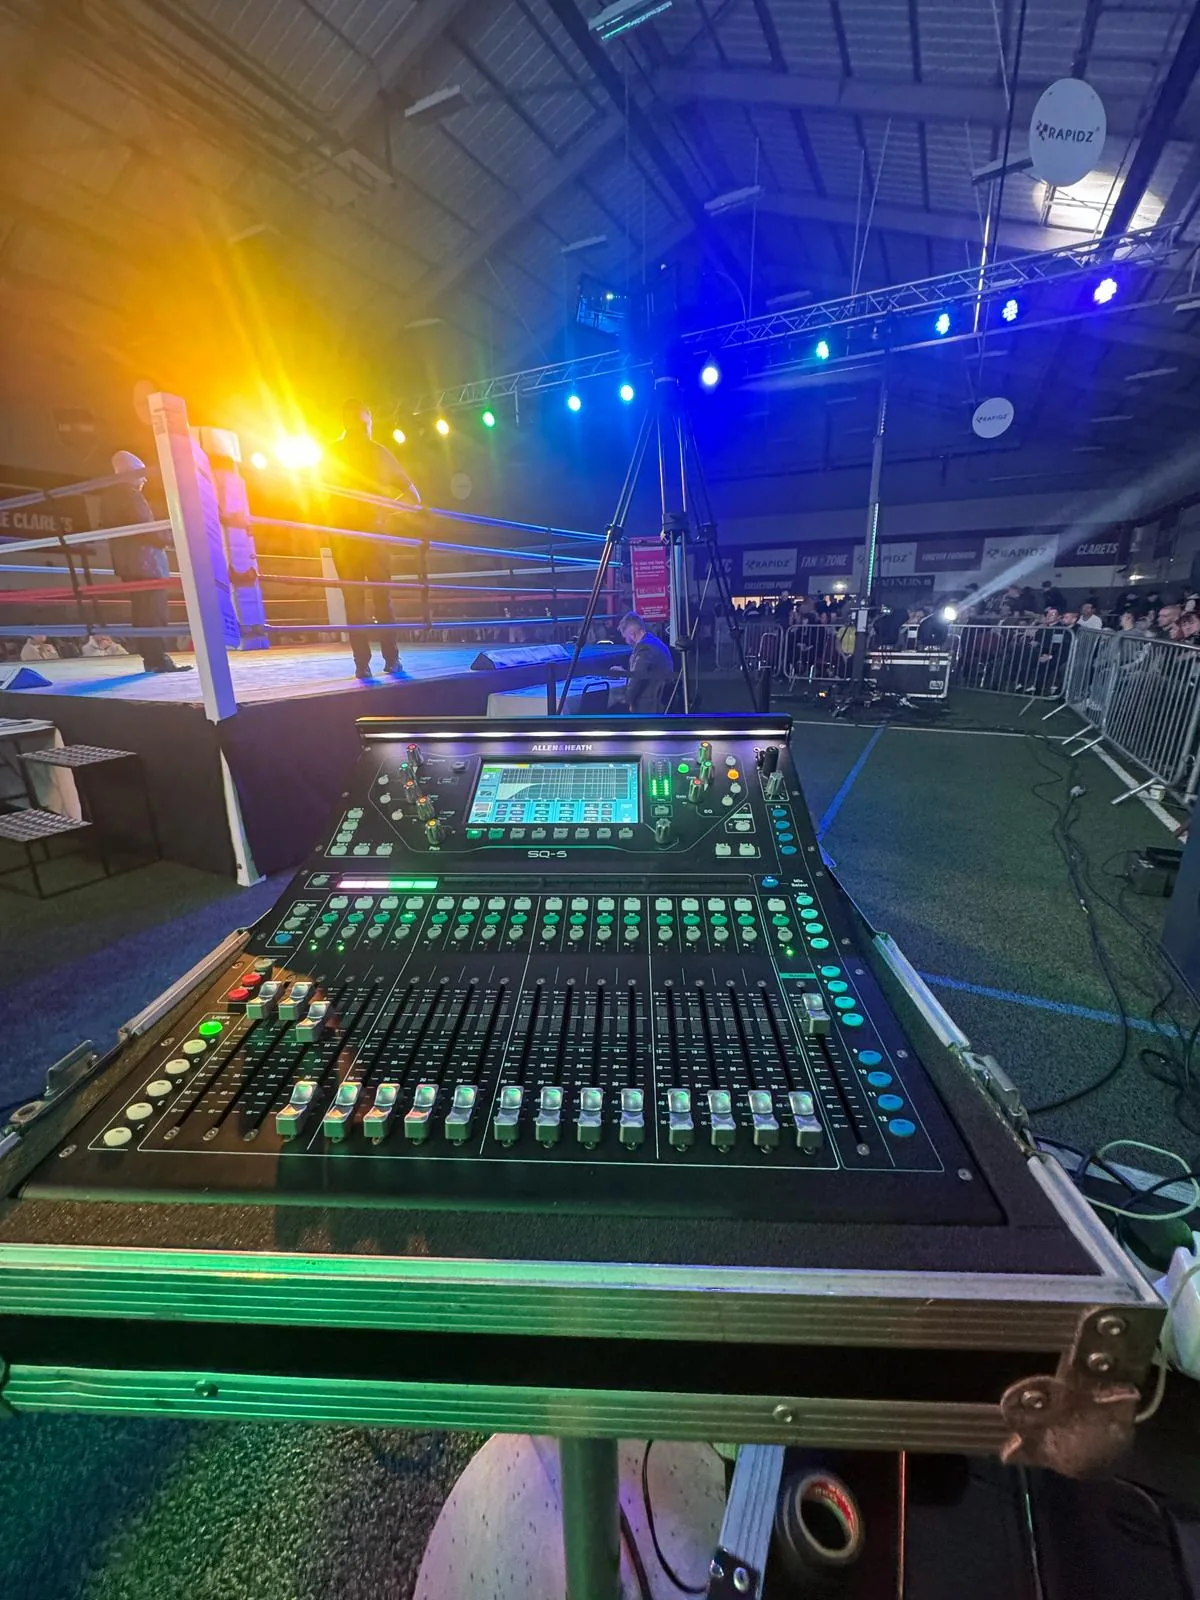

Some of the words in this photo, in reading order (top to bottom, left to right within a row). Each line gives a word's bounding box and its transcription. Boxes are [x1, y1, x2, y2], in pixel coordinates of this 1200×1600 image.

[1048, 127, 1094, 143] RAPIDZ
[1076, 543, 1119, 555] CLARETS
[756, 559, 790, 568] RAPIDZ
[801, 555, 816, 568] FAN
[825, 554, 849, 566] ZONE
[528, 850, 567, 858] SQ-5
